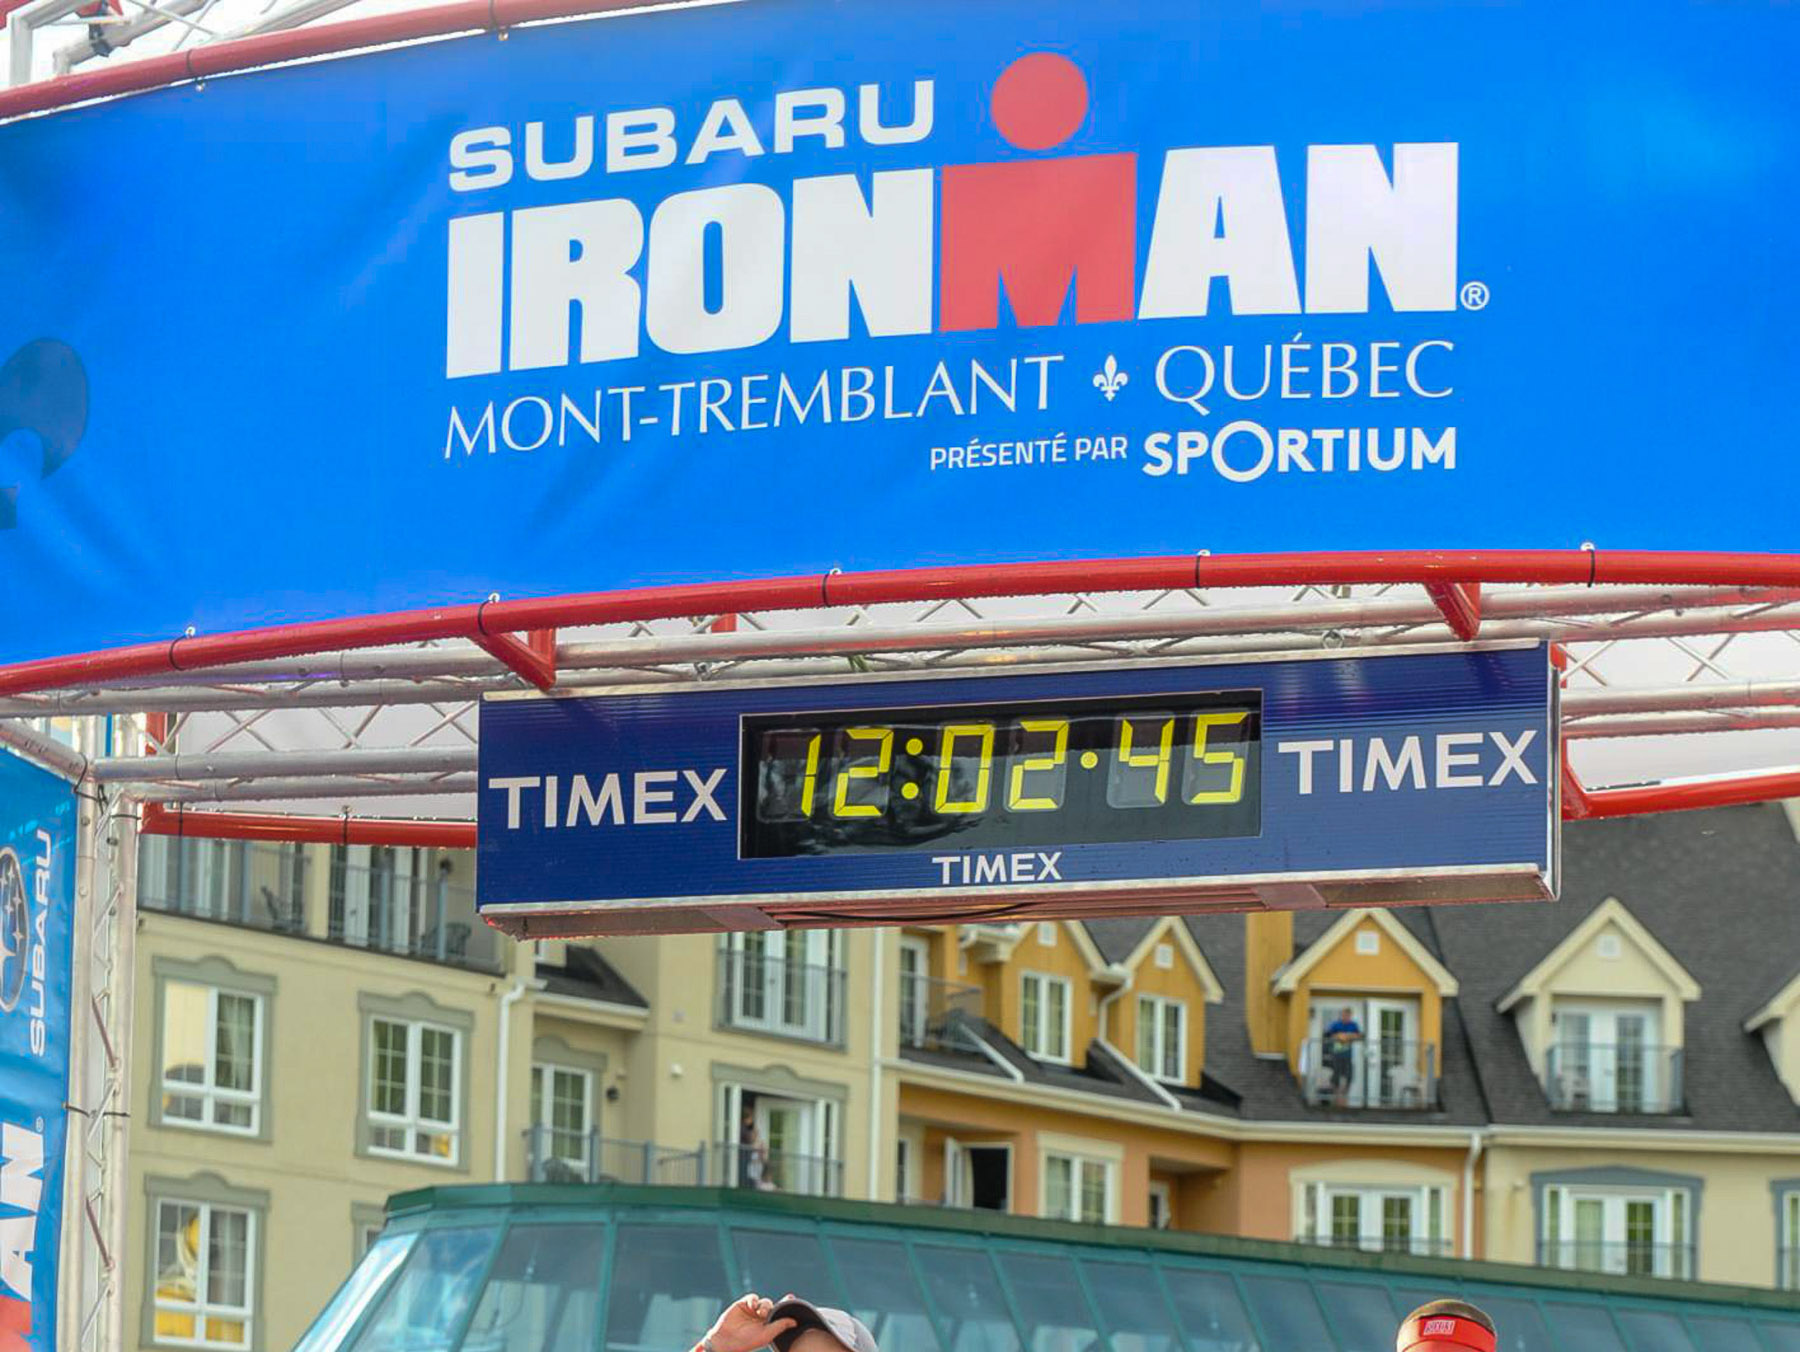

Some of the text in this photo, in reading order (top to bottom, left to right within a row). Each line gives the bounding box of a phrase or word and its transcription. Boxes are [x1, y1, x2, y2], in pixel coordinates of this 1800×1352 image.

[449, 79, 935, 193] SUBARU
[444, 331, 1455, 460] MONT-TREMBLANT QUÉBEC
[930, 419, 1457, 483] PRÉSENTÉ PAR SPORTIUM
[1277, 730, 1538, 796] TIMEX
[488, 768, 728, 830] TIMEX
[931, 851, 1063, 885] TIMEX
[29, 827, 52, 1058] SUBARU
